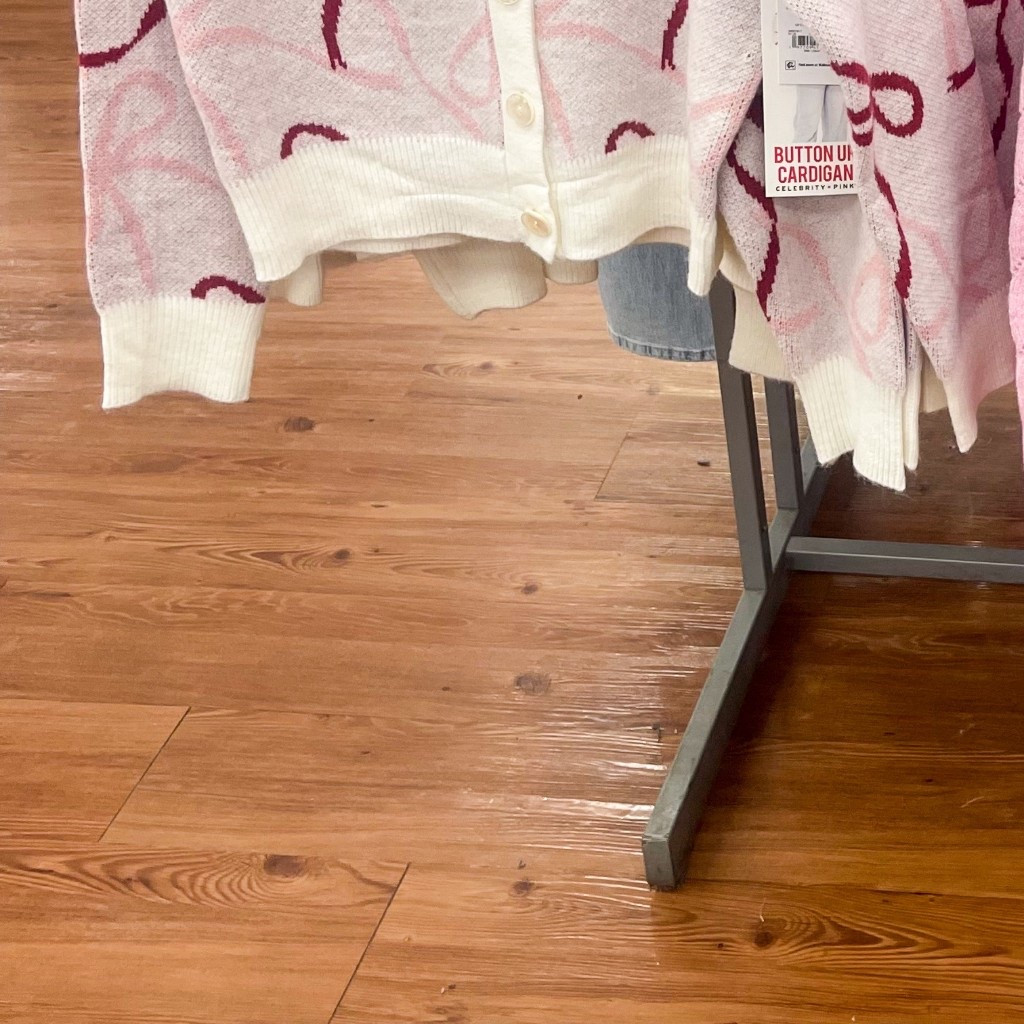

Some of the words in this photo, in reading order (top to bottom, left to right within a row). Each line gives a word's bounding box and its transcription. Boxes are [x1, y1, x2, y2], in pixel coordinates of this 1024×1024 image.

[774, 145, 833, 164] BUTTON
[777, 164, 854, 184] CARDIGAN
[775, 184, 827, 192] CELEBRITY
